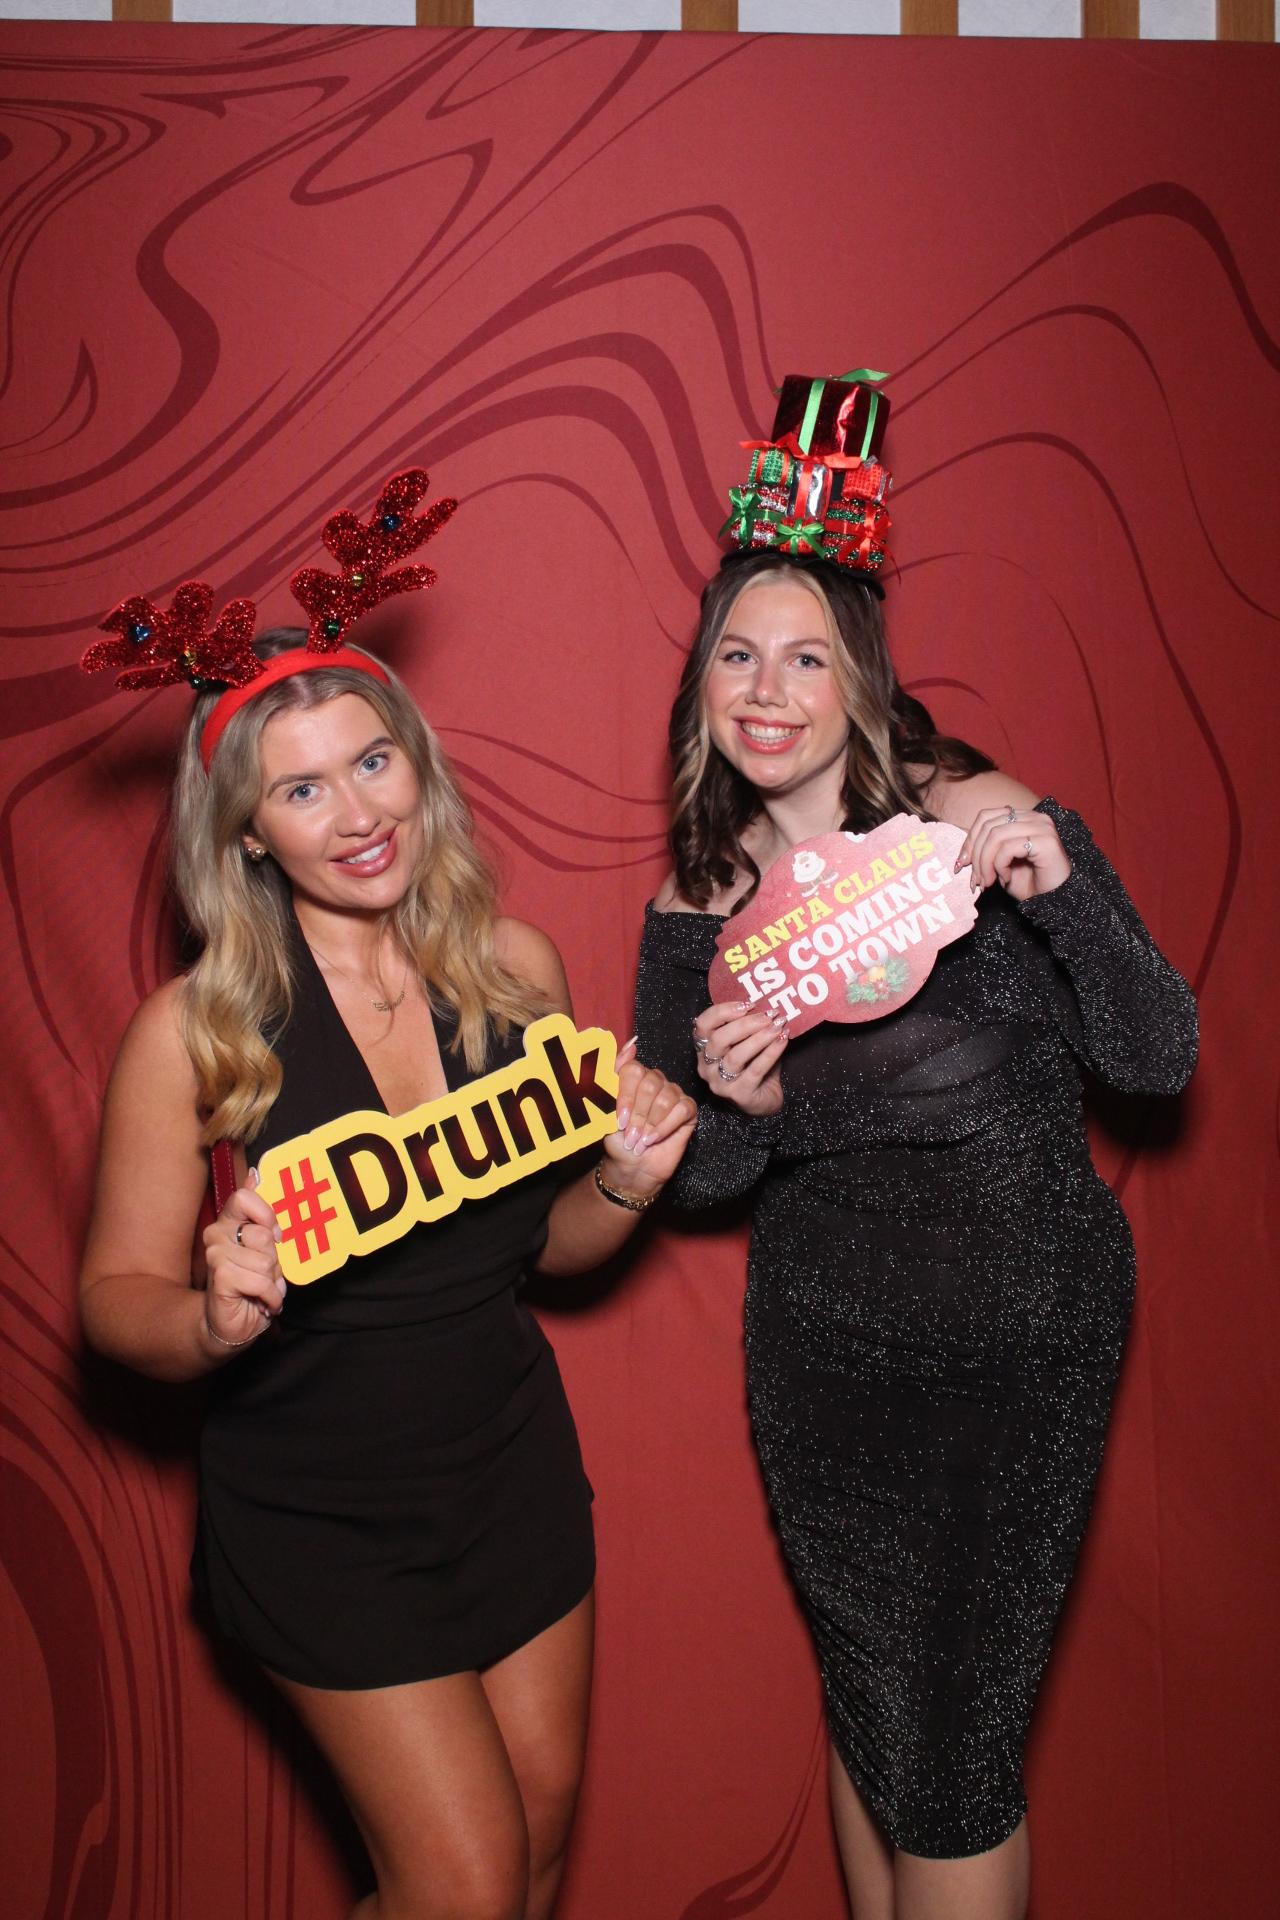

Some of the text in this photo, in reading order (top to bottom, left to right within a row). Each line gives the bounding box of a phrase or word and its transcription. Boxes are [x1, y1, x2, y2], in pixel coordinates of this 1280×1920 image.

[724, 831, 936, 973] SANTA CLAUS
[737, 857, 951, 1001] IS COMING
[768, 894, 955, 1021] TO TOWN
[272, 1035, 617, 1263] #Drunk
